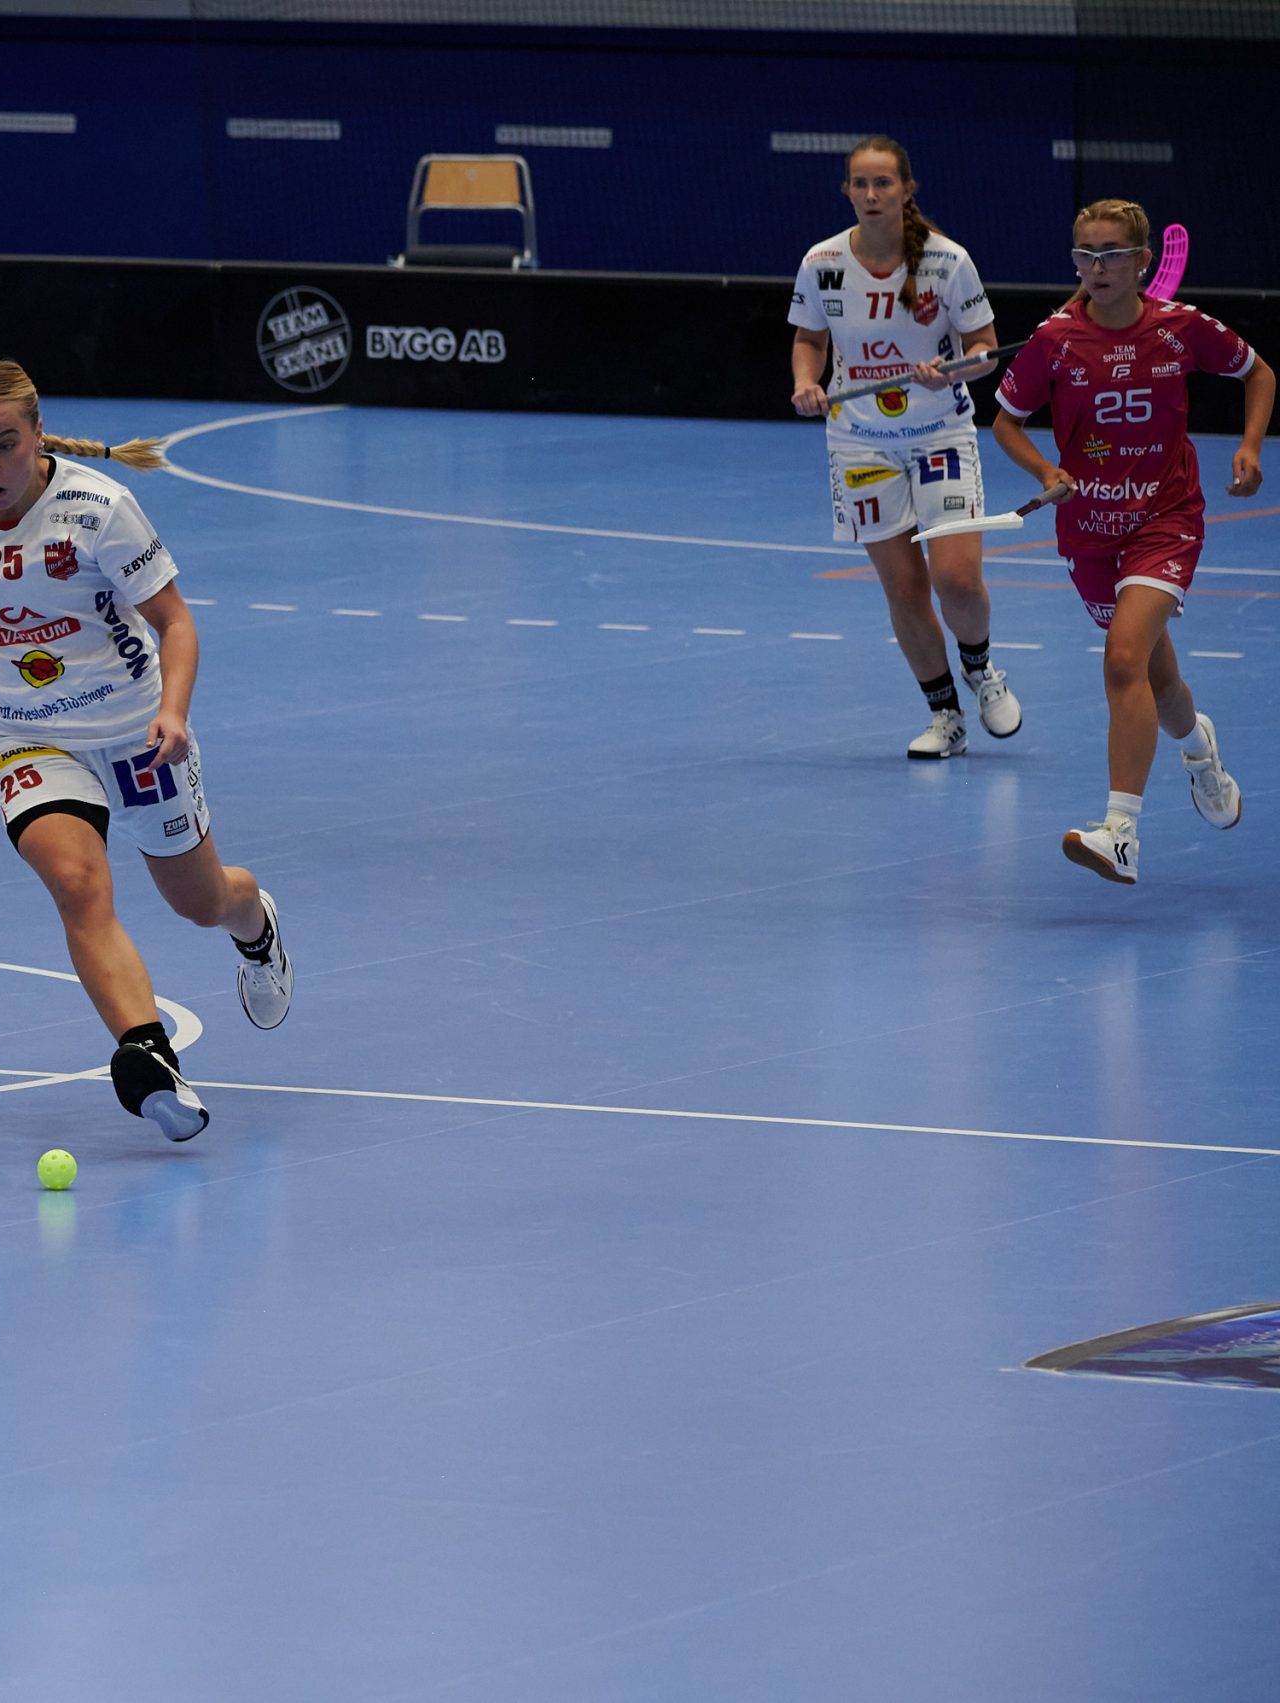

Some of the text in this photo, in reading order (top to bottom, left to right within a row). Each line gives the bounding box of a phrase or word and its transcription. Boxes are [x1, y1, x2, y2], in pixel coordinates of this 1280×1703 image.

[866, 292, 895, 320] 77
[268, 303, 329, 341] TEAM
[366, 325, 506, 363] BYGG AB
[862, 340, 904, 361] ICA
[1113, 344, 1136, 354] TEAM
[1157, 328, 1185, 355] clean
[1102, 353, 1137, 363] SPORTIA
[1094, 388, 1153, 425] 25
[1149, 443, 1163, 453] AB
[55, 490, 111, 506] SKEPPSVIKEN
[1079, 477, 1160, 501] visolve
[853, 497, 880, 526] 77
[0, 763, 43, 805] 25
